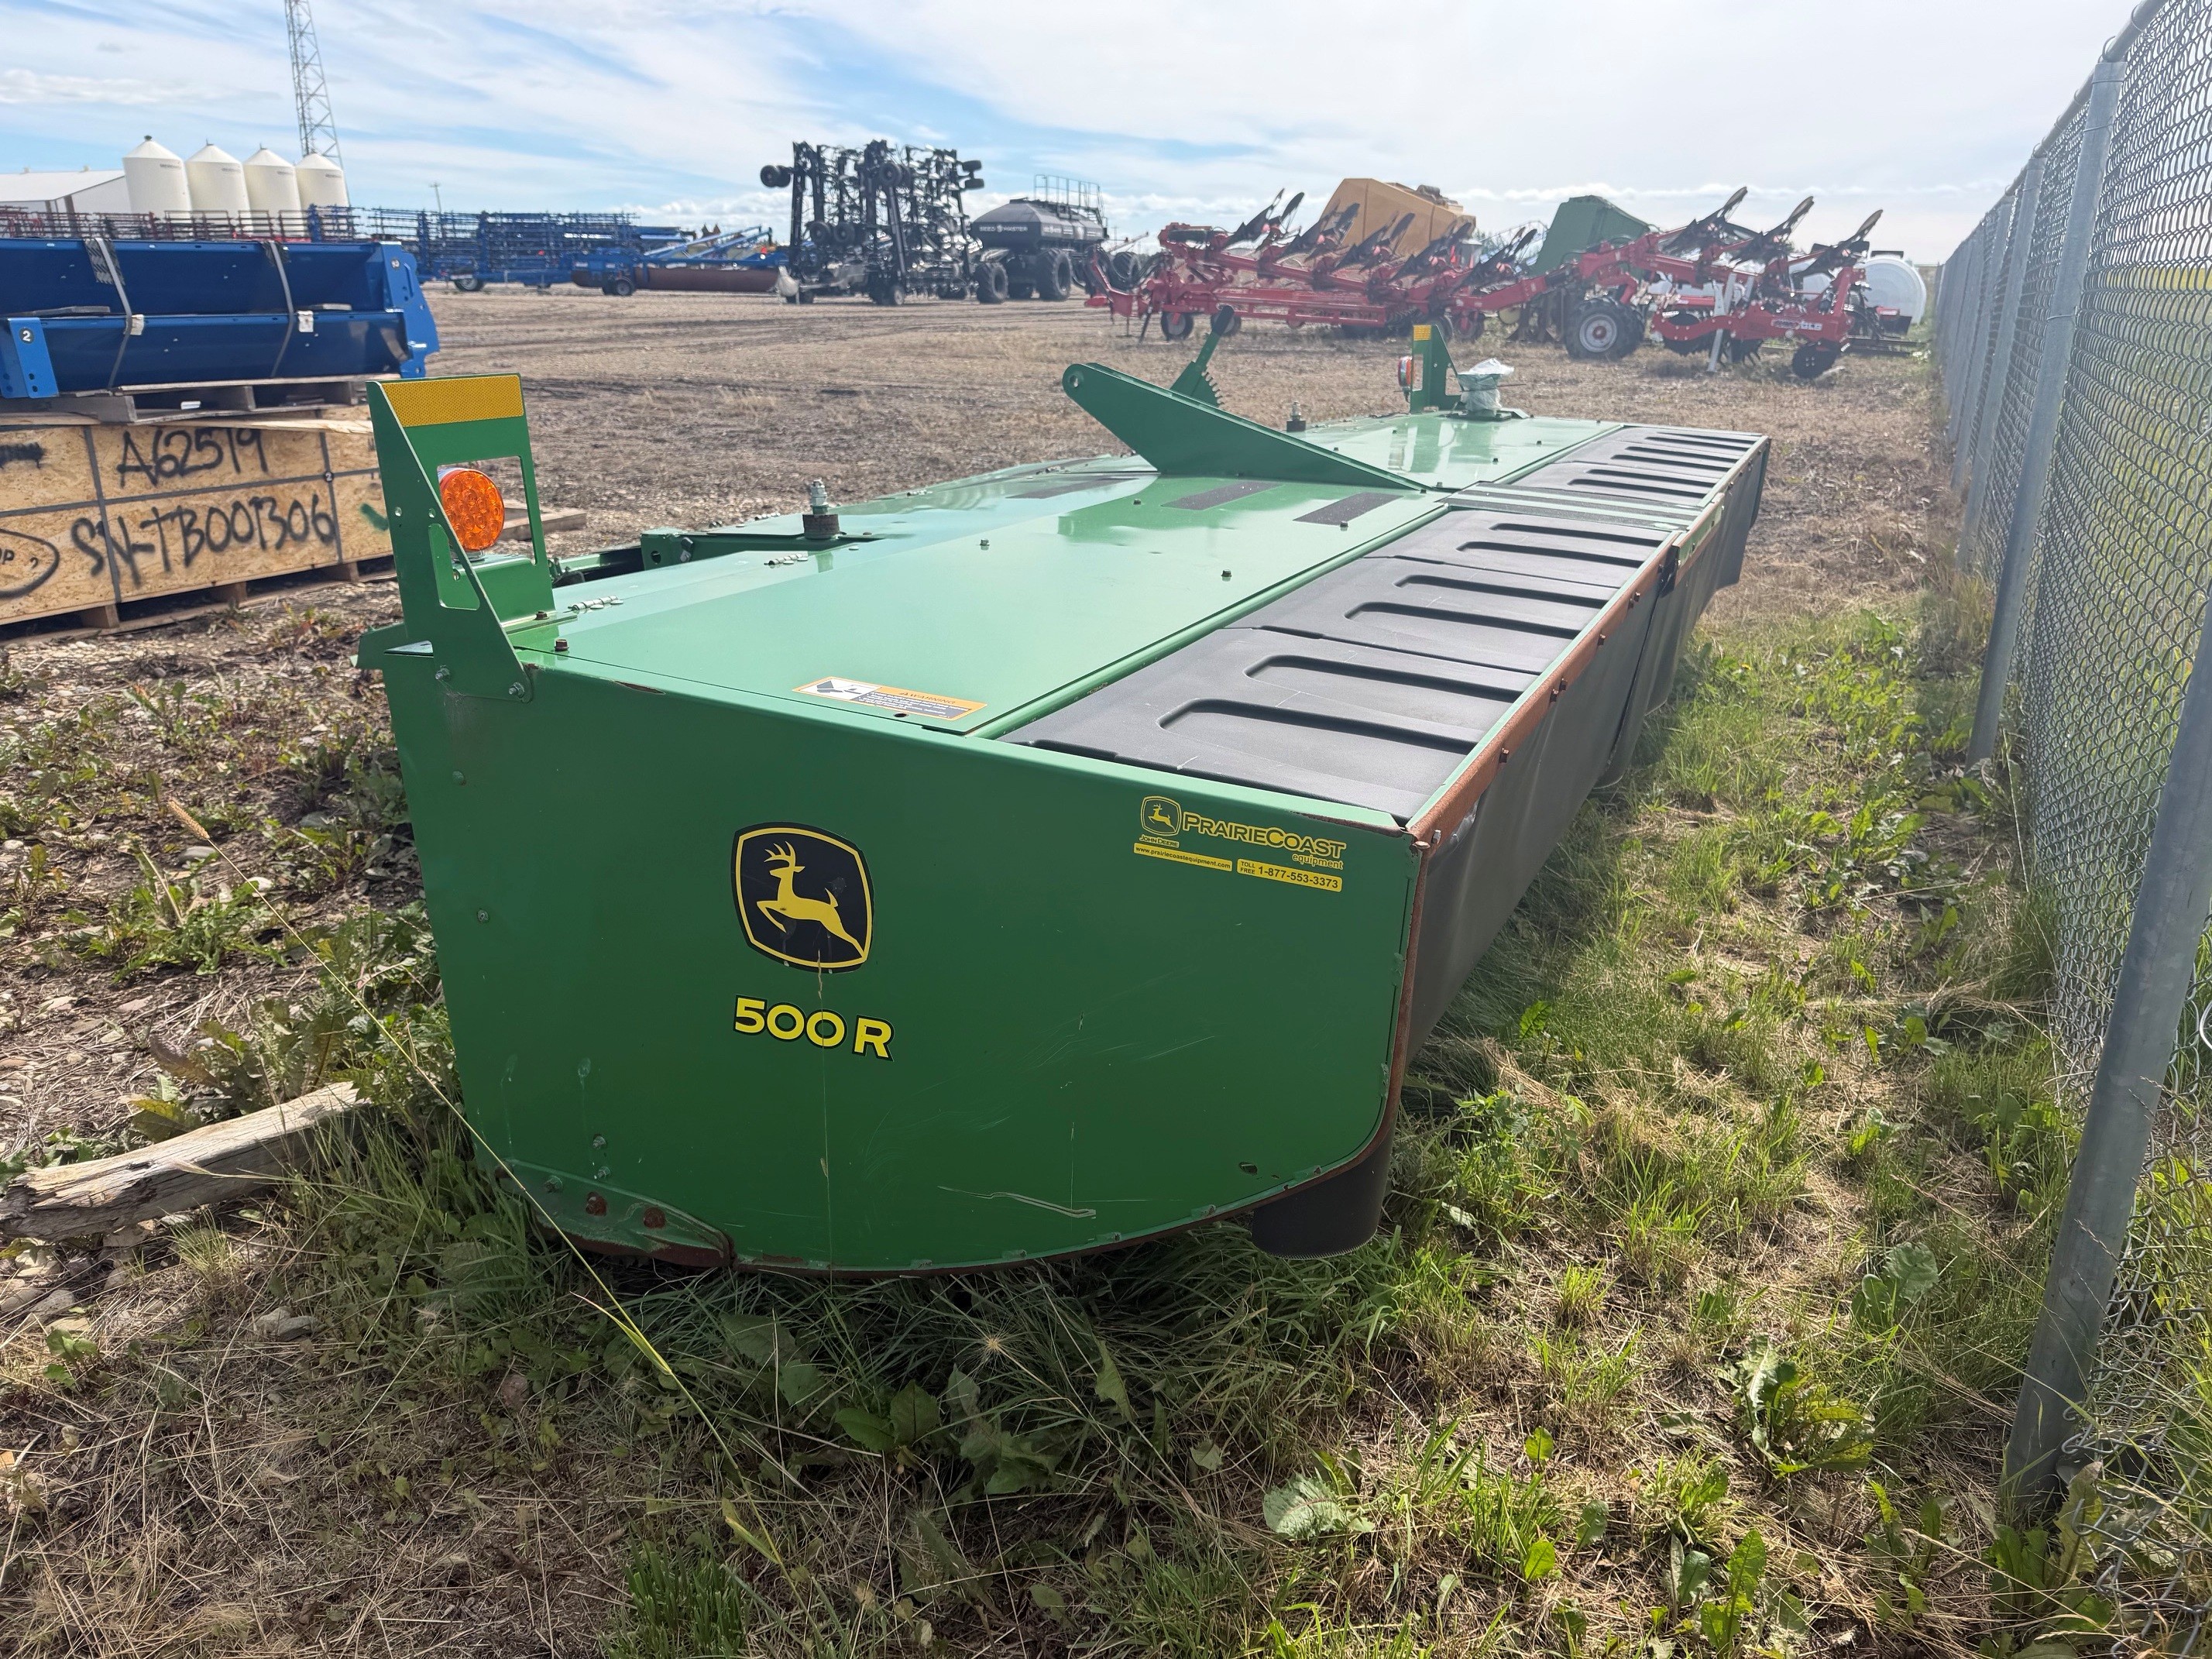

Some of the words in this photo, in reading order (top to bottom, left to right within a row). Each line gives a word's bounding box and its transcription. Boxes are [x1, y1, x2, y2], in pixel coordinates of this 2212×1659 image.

[22, 330, 31, 342] 2
[909, 692, 957, 705] WARNING
[1140, 835, 1157, 843] JOHN
[1157, 837, 1179, 847] DEERE
[1135, 847, 1231, 869] www.prairiecoastequipment.com
[1292, 854, 1344, 870] equipment
[1258, 866, 1338, 889] 1-877-553-3373
[734, 995, 847, 1049] 500
[853, 1015, 893, 1060] R
